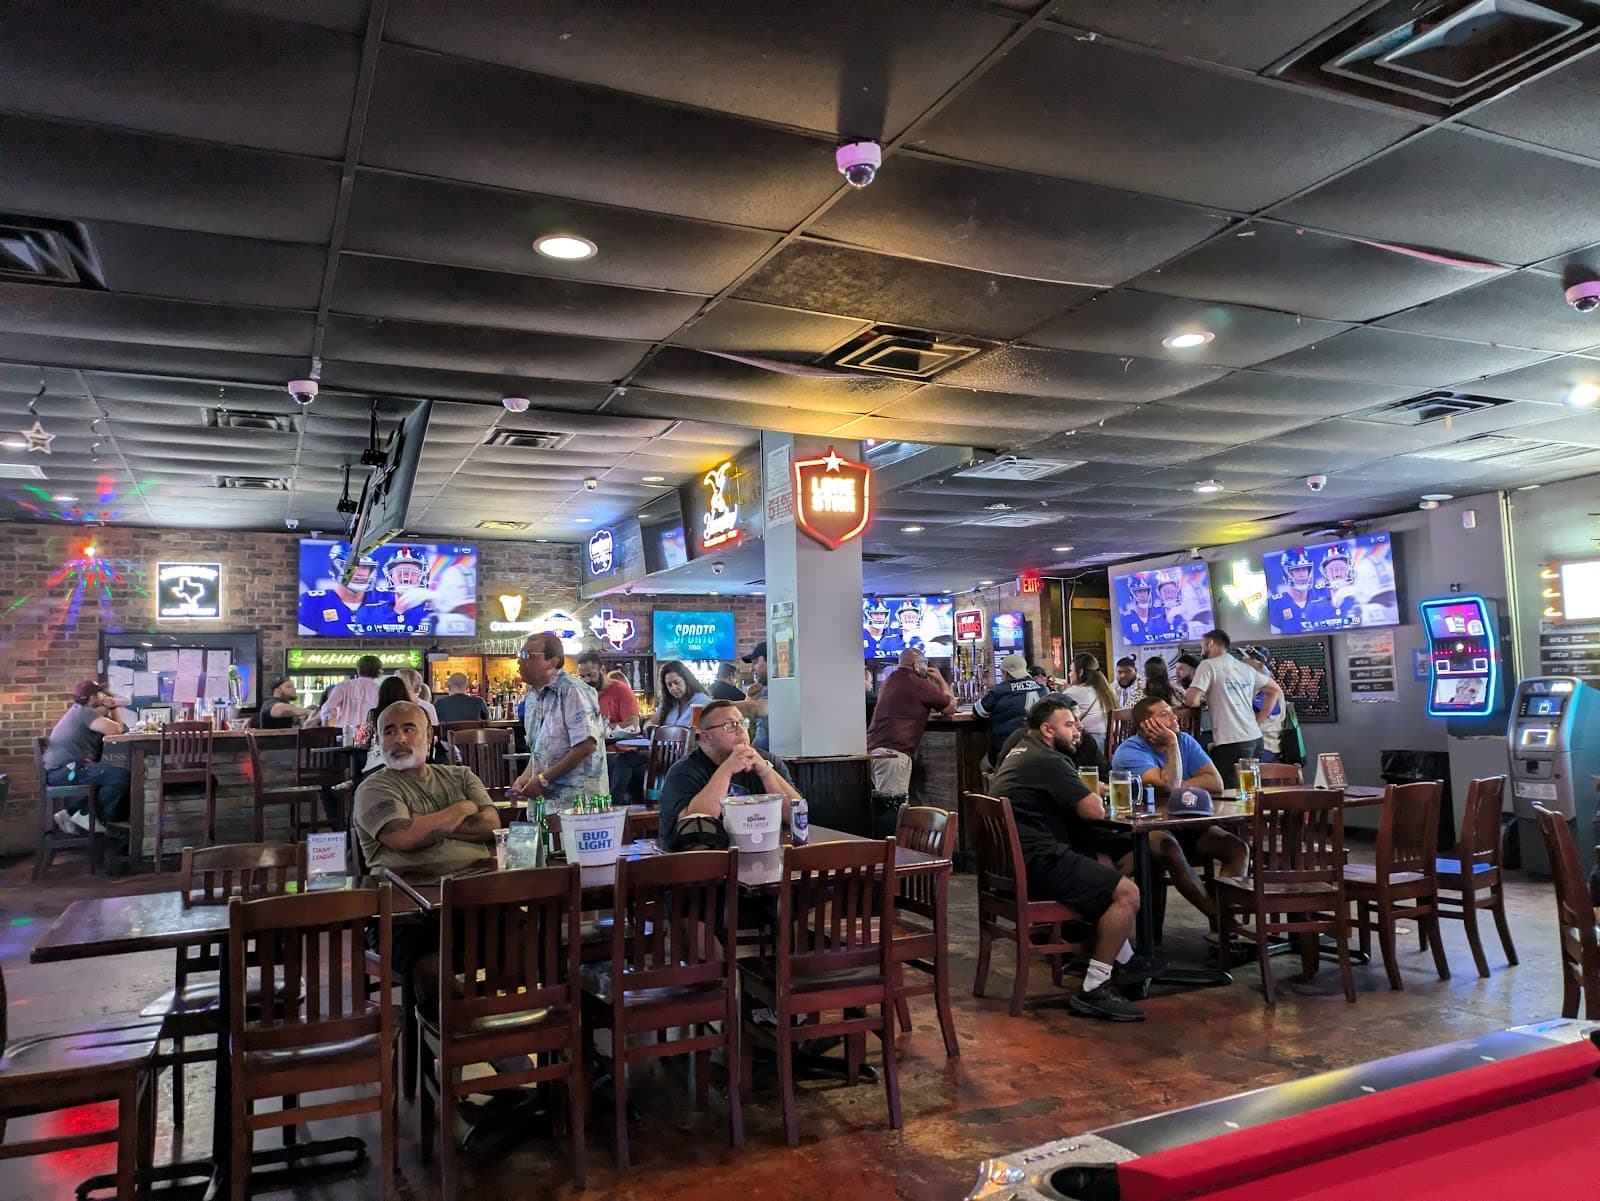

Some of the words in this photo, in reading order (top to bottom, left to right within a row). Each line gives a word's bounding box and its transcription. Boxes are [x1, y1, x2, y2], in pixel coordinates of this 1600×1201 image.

[1023, 578, 1037, 593] EXIT
[957, 621, 980, 633] TEXANS
[673, 624, 716, 644] SPORTS
[582, 831, 609, 841] BUD
[578, 839, 612, 850] LIGHT
